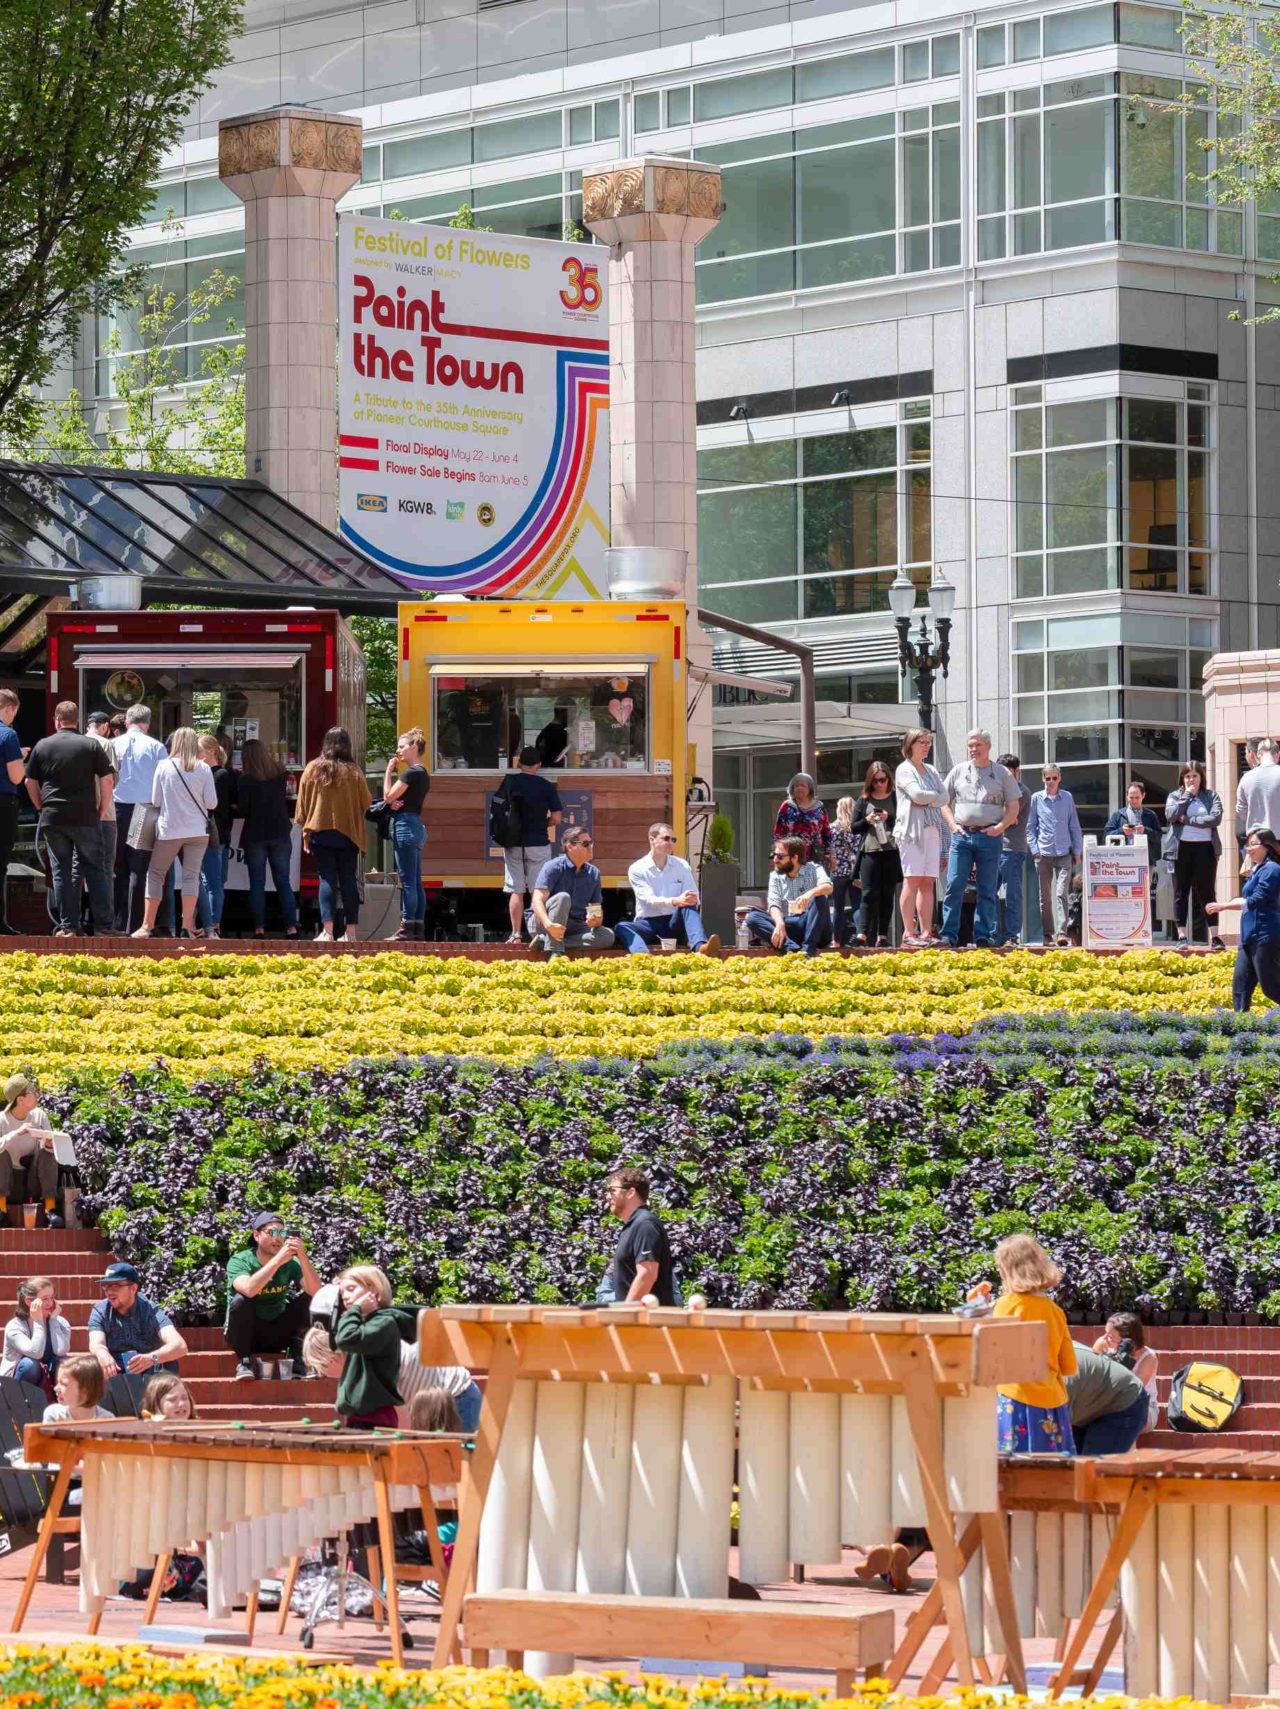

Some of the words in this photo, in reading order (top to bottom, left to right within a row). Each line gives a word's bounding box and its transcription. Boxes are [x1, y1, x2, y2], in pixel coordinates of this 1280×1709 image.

[354, 226, 428, 258] Festival
[433, 240, 453, 261] of
[459, 240, 531, 270] Flowers
[395, 262, 433, 277] WALKER
[560, 256, 603, 312] 35
[353, 274, 445, 334] Paint
[353, 332, 413, 382] the
[421, 335, 524, 394] Town
[353, 392, 361, 404] A
[365, 393, 398, 408] Tribute
[402, 397, 413, 410] to
[416, 399, 432, 412] the
[436, 402, 458, 415] 35th
[462, 404, 523, 424] Anniversary
[353, 409, 365, 420] of
[367, 409, 405, 424] Pioneer
[409, 414, 469, 432] Courthouse
[472, 423, 509, 436] Square
[386, 440, 410, 453] Floral
[413, 443, 449, 459] Display
[451, 448, 470, 462] May
[473, 450, 483, 461] 22
[491, 452, 510, 463] June
[512, 453, 518, 463] 4
[386, 461, 416, 475] Flower
[420, 465, 441, 479] Sale
[444, 467, 476, 483] Begins
[479, 472, 498, 483] 8am
[501, 473, 520, 485] June
[523, 476, 528, 486] 5
[360, 498, 385, 508] IKEA
[535, 527, 580, 590] THESQUAREPDX.ORG
[1115, 868, 1136, 876] Town
